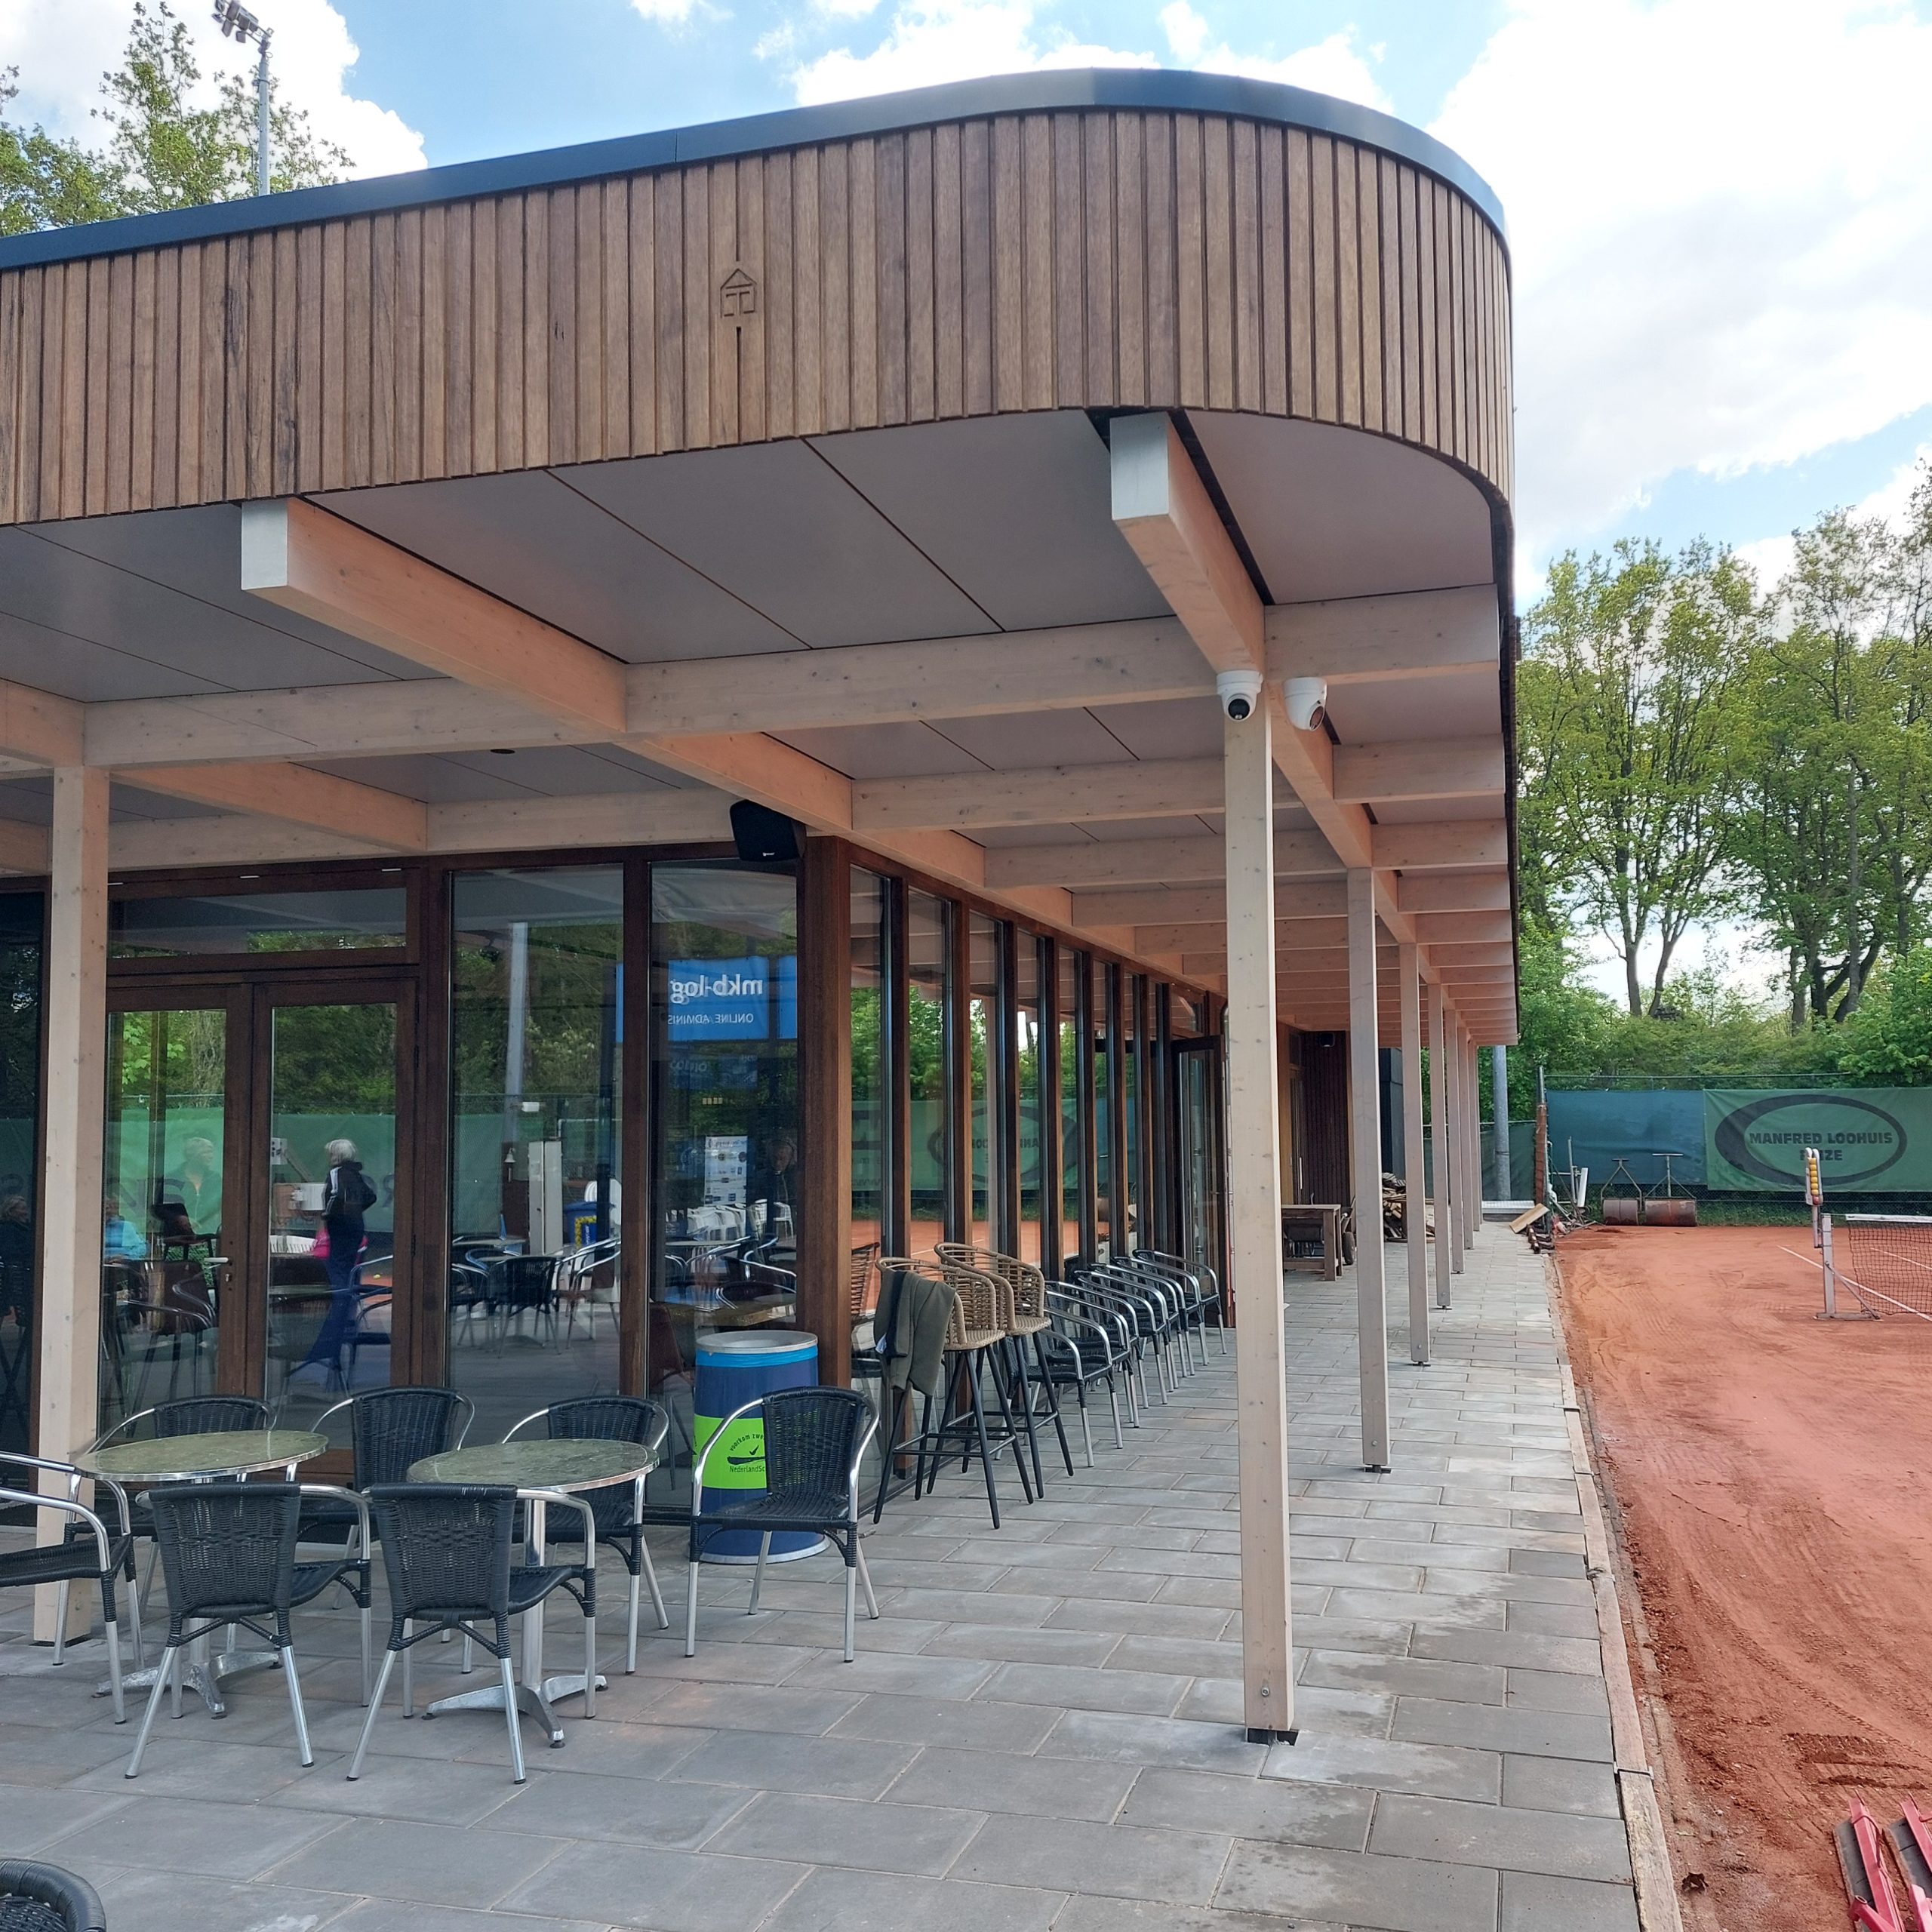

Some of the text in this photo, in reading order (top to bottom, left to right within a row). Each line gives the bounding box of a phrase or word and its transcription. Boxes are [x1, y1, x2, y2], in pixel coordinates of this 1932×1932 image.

[1749, 1132, 1894, 1144] MANFRED LOOHUIS
[729, 1434, 751, 1451] voorkom
